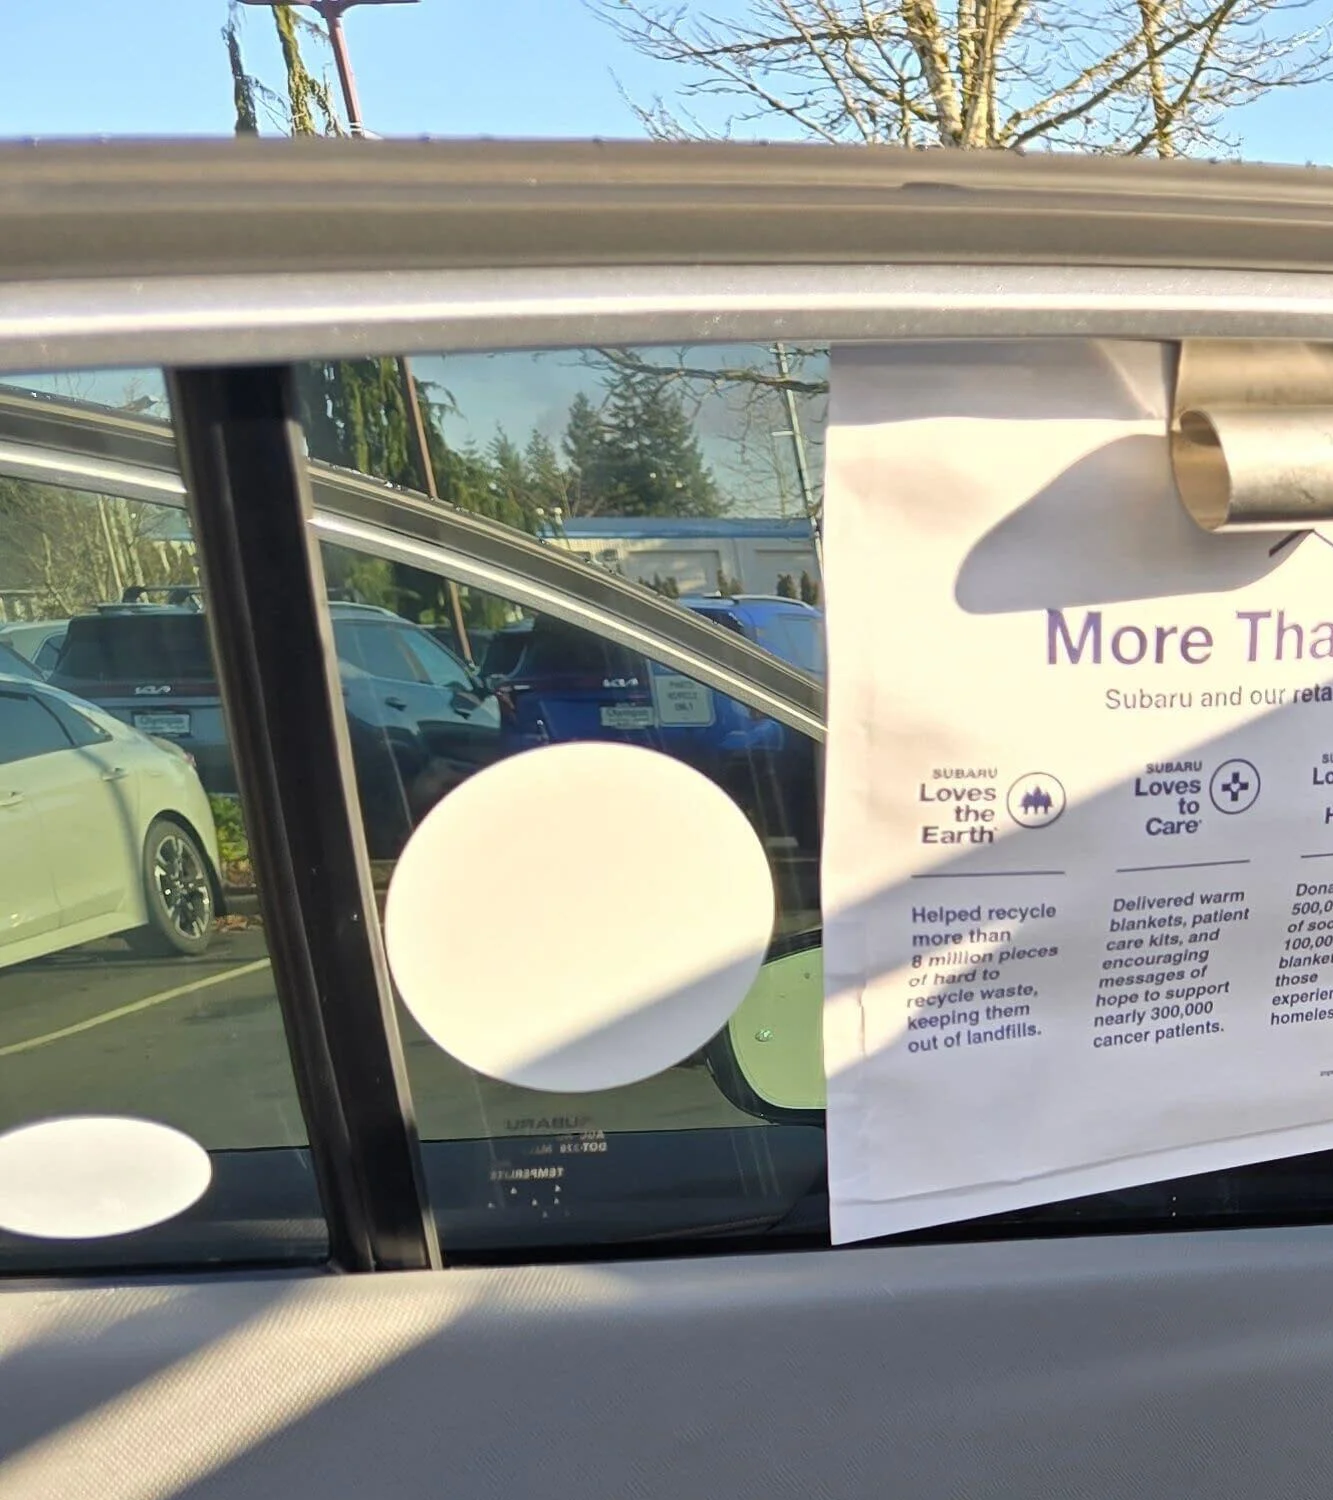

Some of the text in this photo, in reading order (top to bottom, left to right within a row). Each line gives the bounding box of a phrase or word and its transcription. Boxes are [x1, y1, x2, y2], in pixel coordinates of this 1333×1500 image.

[1047, 608, 1213, 665] More
[1105, 688, 1192, 709] Subaru
[1201, 686, 1241, 707] and
[1250, 687, 1285, 705] our
[932, 768, 998, 780] SUBARU
[1146, 760, 1202, 774] SUBARU
[920, 784, 997, 802] Loves
[1135, 777, 1201, 796] Loves
[955, 805, 995, 822] the
[1178, 798, 1200, 815] to
[922, 826, 994, 844] Earth
[1146, 818, 1198, 837] Care
[1113, 891, 1245, 912] Delivered warm
[912, 903, 1056, 925] Helped recycle
[1110, 908, 1249, 932] blankets, patient
[1288, 920, 1304, 933] of
[912, 929, 1011, 947] more than
[1106, 928, 1220, 951] care kits, and
[912, 946, 1058, 968] 8 million pieces
[1102, 949, 1209, 970] encouraging
[908, 969, 1000, 987] of hard to
[1099, 965, 1208, 988] messages of
[1275, 973, 1318, 987] those
[906, 984, 1038, 1008] recycle waste,
[1096, 981, 1230, 1008] hope to support
[908, 1005, 1029, 1030] keeping them
[1094, 1001, 1213, 1027] nearly 300,000
[908, 1022, 1042, 1053] out of landfills.
[1094, 1021, 1224, 1048] cancer patients.
